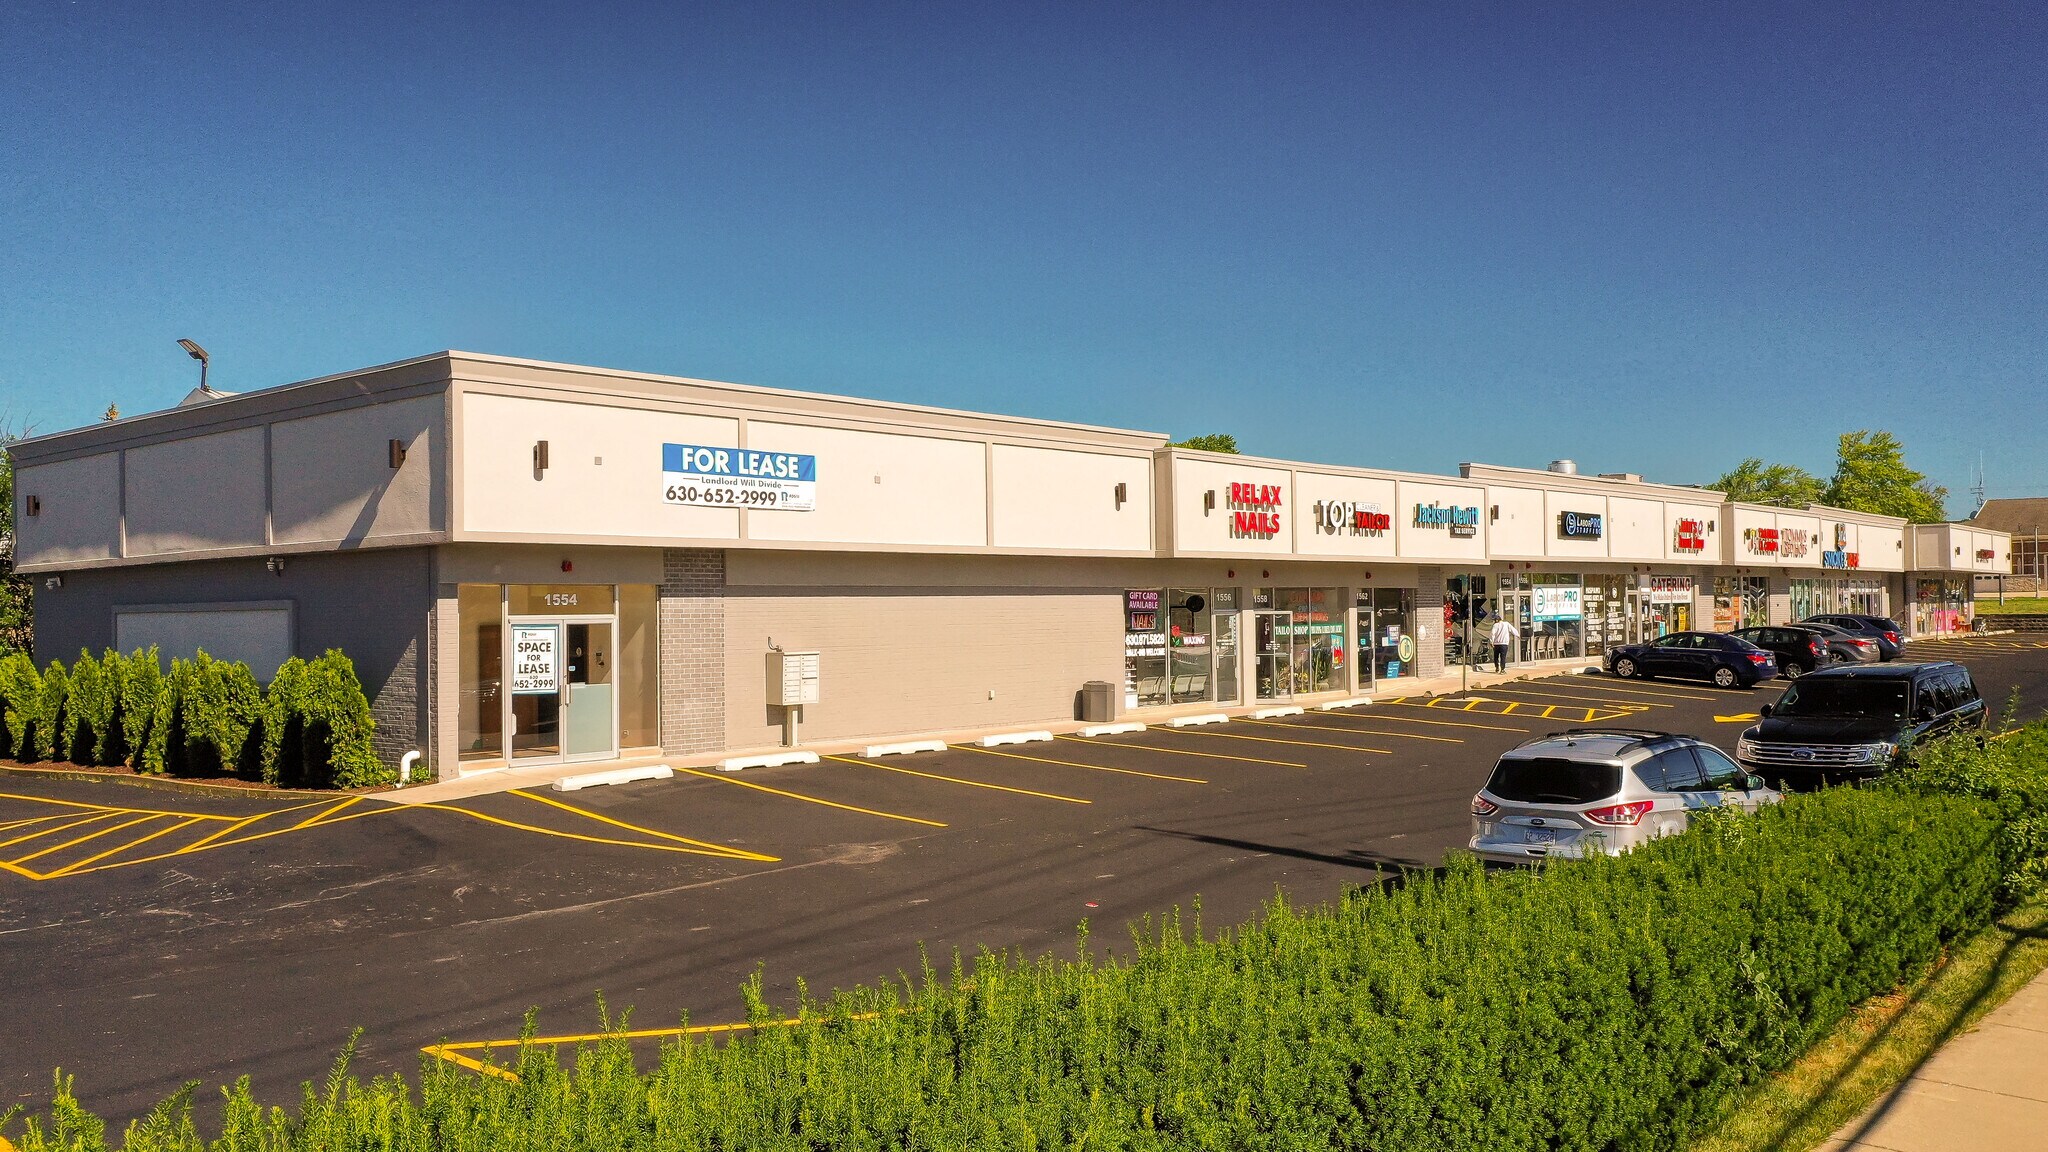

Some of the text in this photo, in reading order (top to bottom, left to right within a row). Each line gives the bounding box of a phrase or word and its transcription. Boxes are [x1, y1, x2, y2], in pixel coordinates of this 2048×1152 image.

[682, 447, 799, 479] FOR LEASE
[701, 476, 782, 489] Landlord Will Divide
[665, 485, 777, 506] 630-652-2999
[1231, 481, 1282, 506] RELAX
[1320, 500, 1354, 528] TOP
[1418, 503, 1479, 525] Jackson Hewitt
[1233, 510, 1281, 534] NAILS
[1355, 511, 1390, 531] TAILOR
[1651, 577, 1691, 593] CATERING
[544, 593, 578, 606] 1554
[1129, 592, 1158, 600] GIFT CARD
[1216, 594, 1232, 602] 1556
[1253, 594, 1268, 603] 1558
[1128, 601, 1158, 609] AVAILABLE
[1275, 626, 1292, 635] TAILO
[1294, 625, 1309, 635] SHOP
[1182, 636, 1206, 645] WAXING
[517, 641, 552, 653] SPACE
[526, 654, 541, 662] FOR
[518, 663, 550, 675] LEASE
[514, 679, 554, 688] 652-2999
